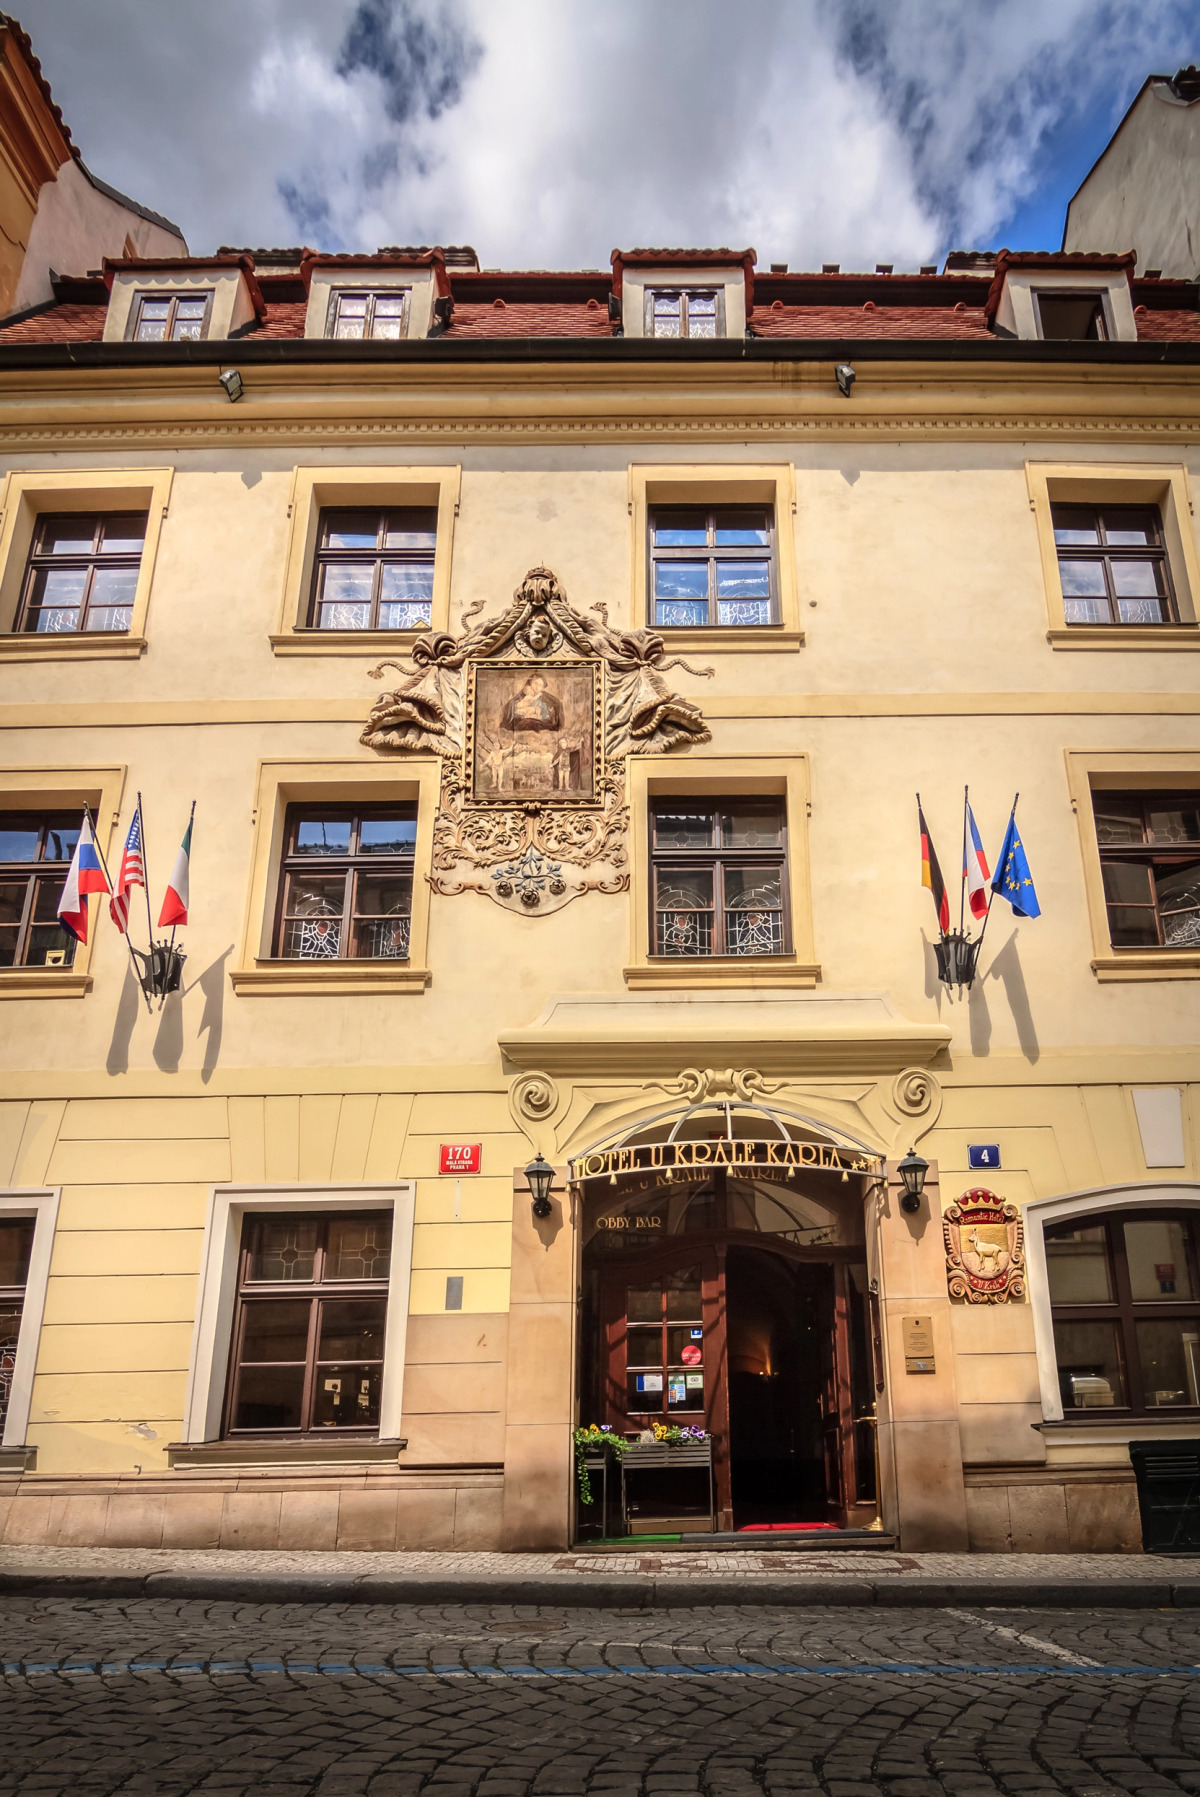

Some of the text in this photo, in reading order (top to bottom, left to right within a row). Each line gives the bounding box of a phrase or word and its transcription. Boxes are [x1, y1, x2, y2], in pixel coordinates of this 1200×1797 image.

[448, 1147, 471, 1160] 170
[574, 1135, 843, 1179] HOTEL U KRÁLE KARLA
[981, 1149, 990, 1163] 4
[635, 1216, 662, 1228] BAR
[988, 1211, 1005, 1224] Hotel
